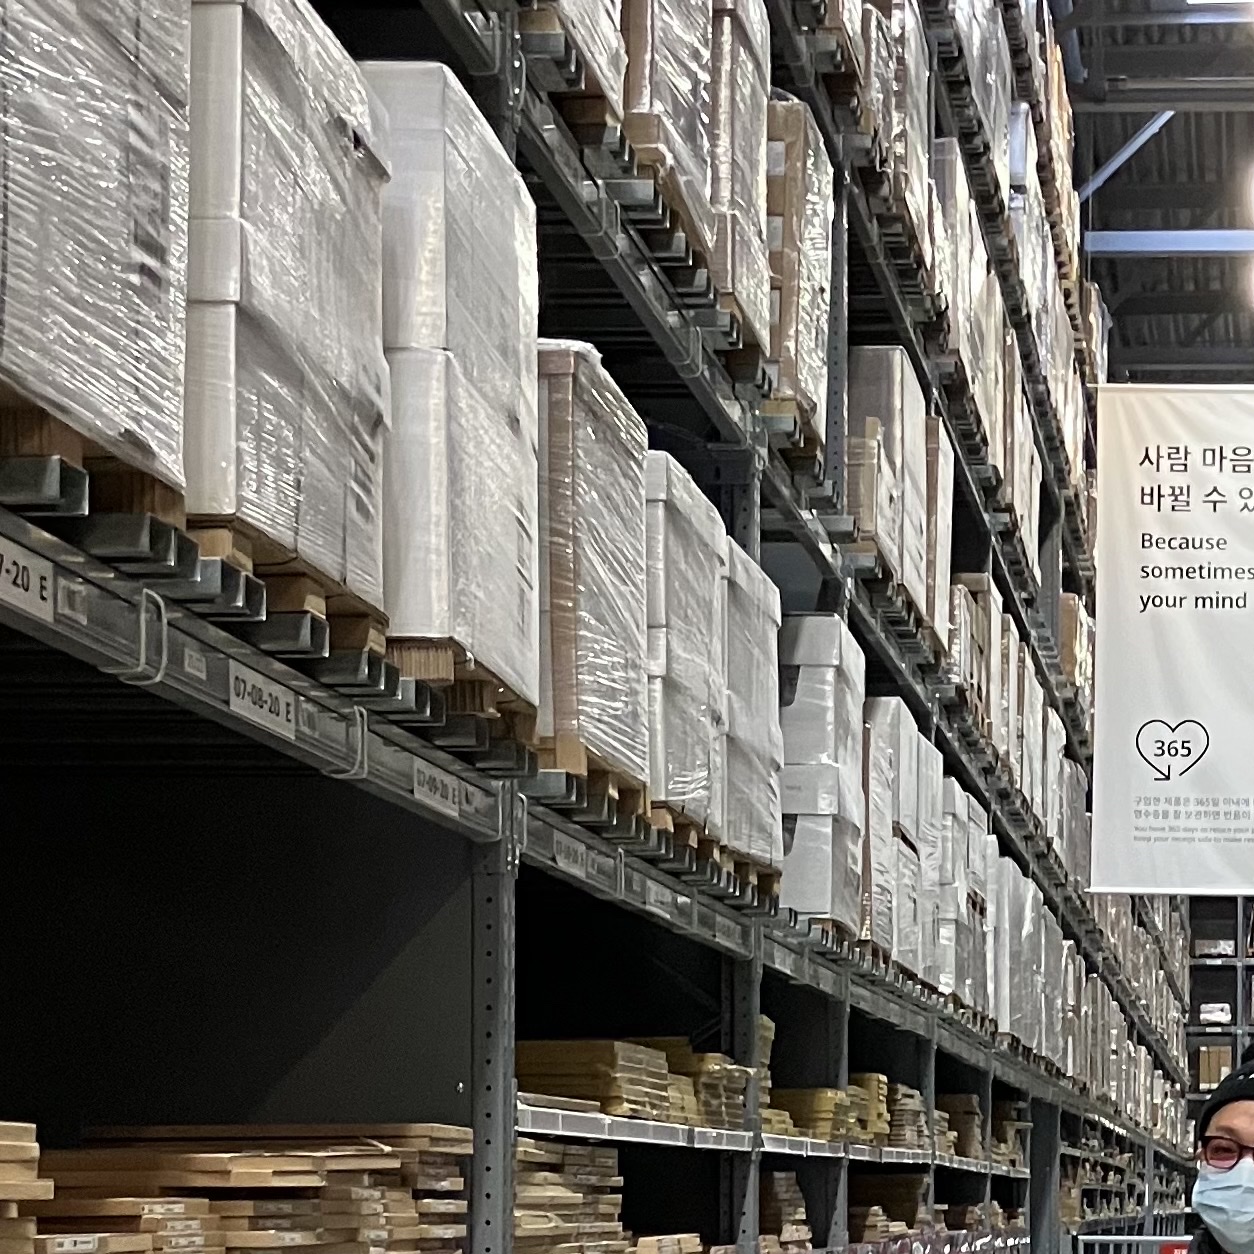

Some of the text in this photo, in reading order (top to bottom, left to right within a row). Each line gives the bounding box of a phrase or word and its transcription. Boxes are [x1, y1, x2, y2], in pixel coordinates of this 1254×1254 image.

[1139, 445, 1192, 474] 사람
[1140, 484, 1192, 513] 바뀔
[1202, 486, 1228, 513] 수
[1141, 532, 1228, 551] Because
[40, 576, 47, 601] E
[1139, 591, 1248, 613] your mind
[285, 702, 291, 722] E
[1153, 739, 1193, 758] 365
